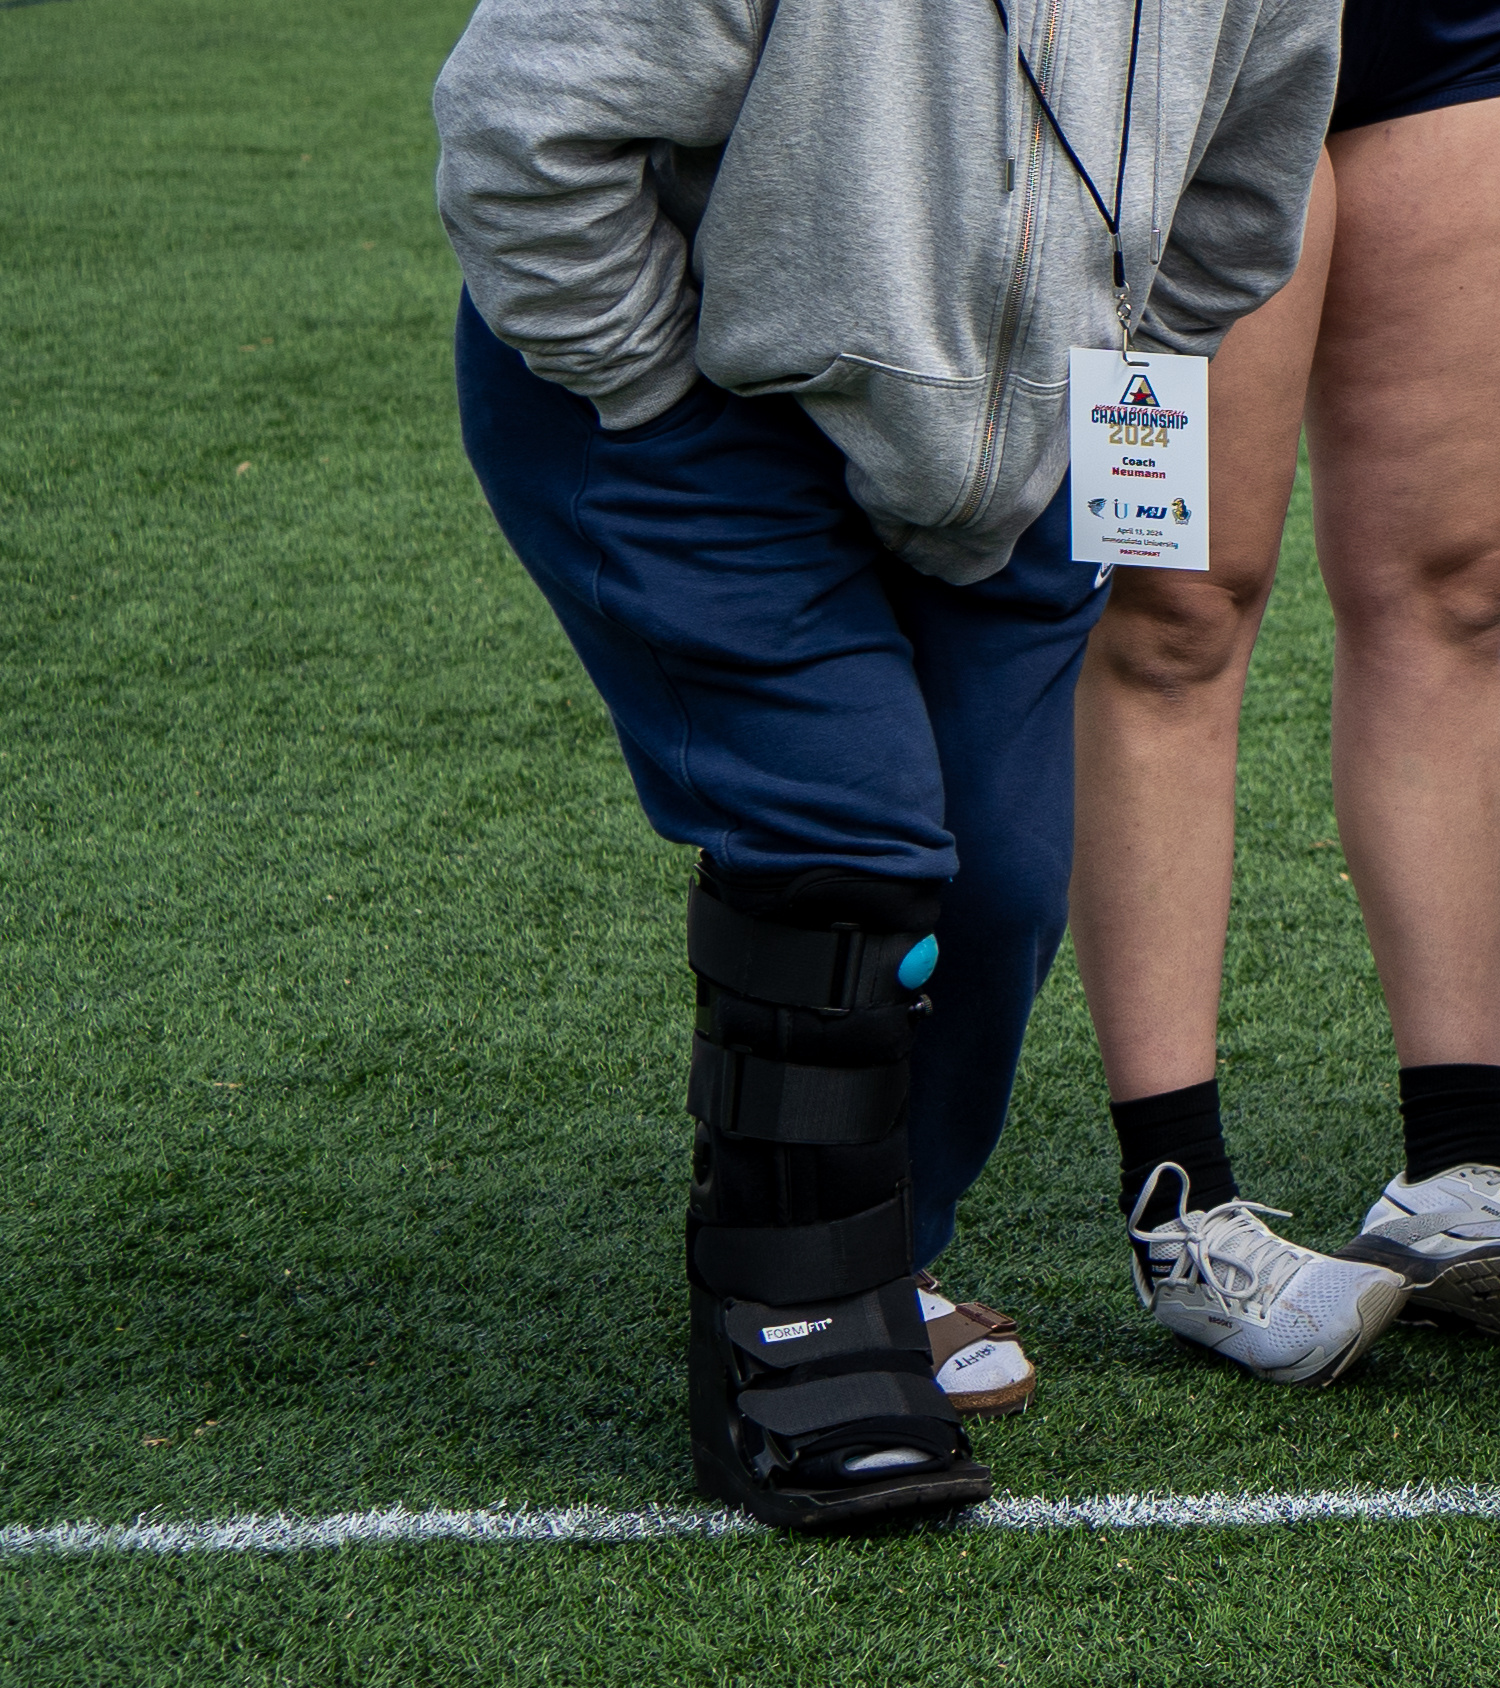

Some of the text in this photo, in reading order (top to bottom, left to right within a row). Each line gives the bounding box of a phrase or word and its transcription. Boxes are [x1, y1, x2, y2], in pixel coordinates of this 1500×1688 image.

[1091, 408, 1189, 430] CHAMPIONSHIP
[1109, 423, 1170, 448] 2024
[1122, 456, 1156, 468] Coach
[1112, 467, 1166, 479] Neumann
